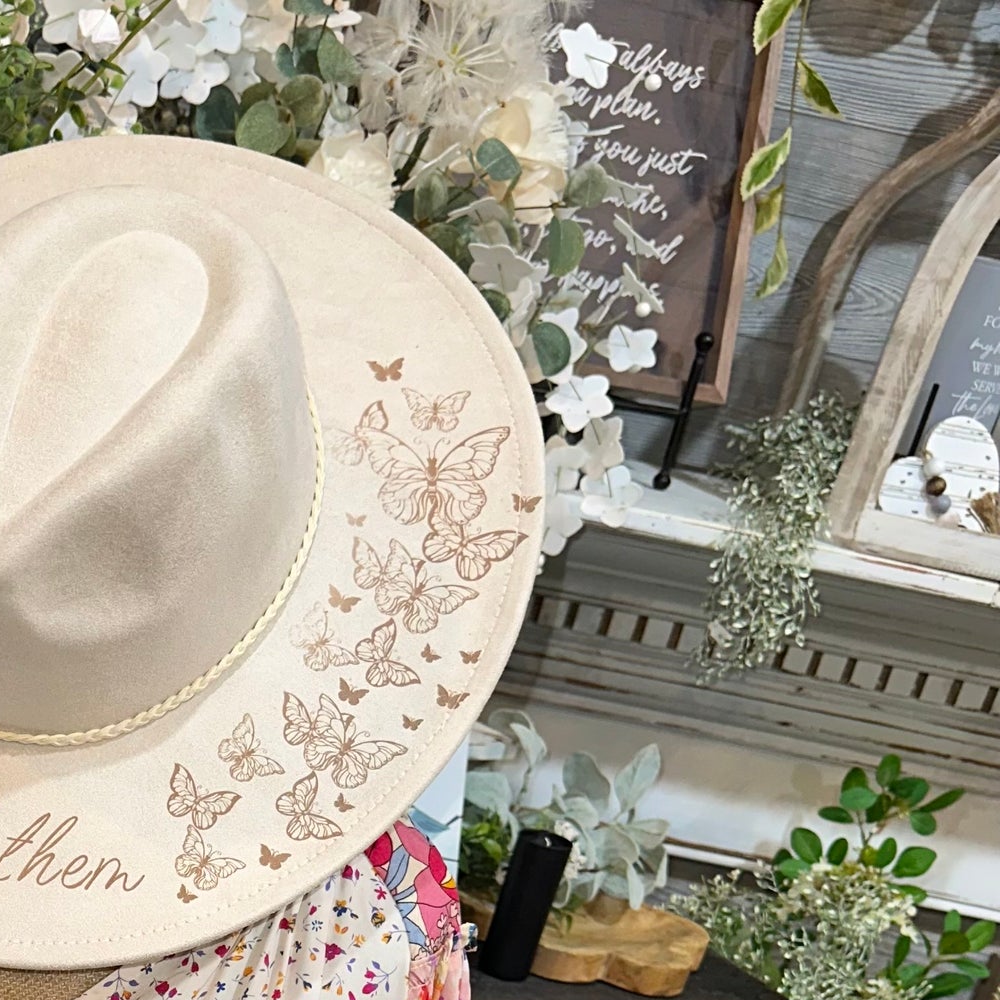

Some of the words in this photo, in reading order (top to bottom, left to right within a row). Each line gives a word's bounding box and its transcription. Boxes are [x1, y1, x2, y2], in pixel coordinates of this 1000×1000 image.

[589, 86, 661, 125] plan.
[593, 137, 642, 164] you
[637, 145, 708, 178] just
[972, 360, 991, 375] WE
